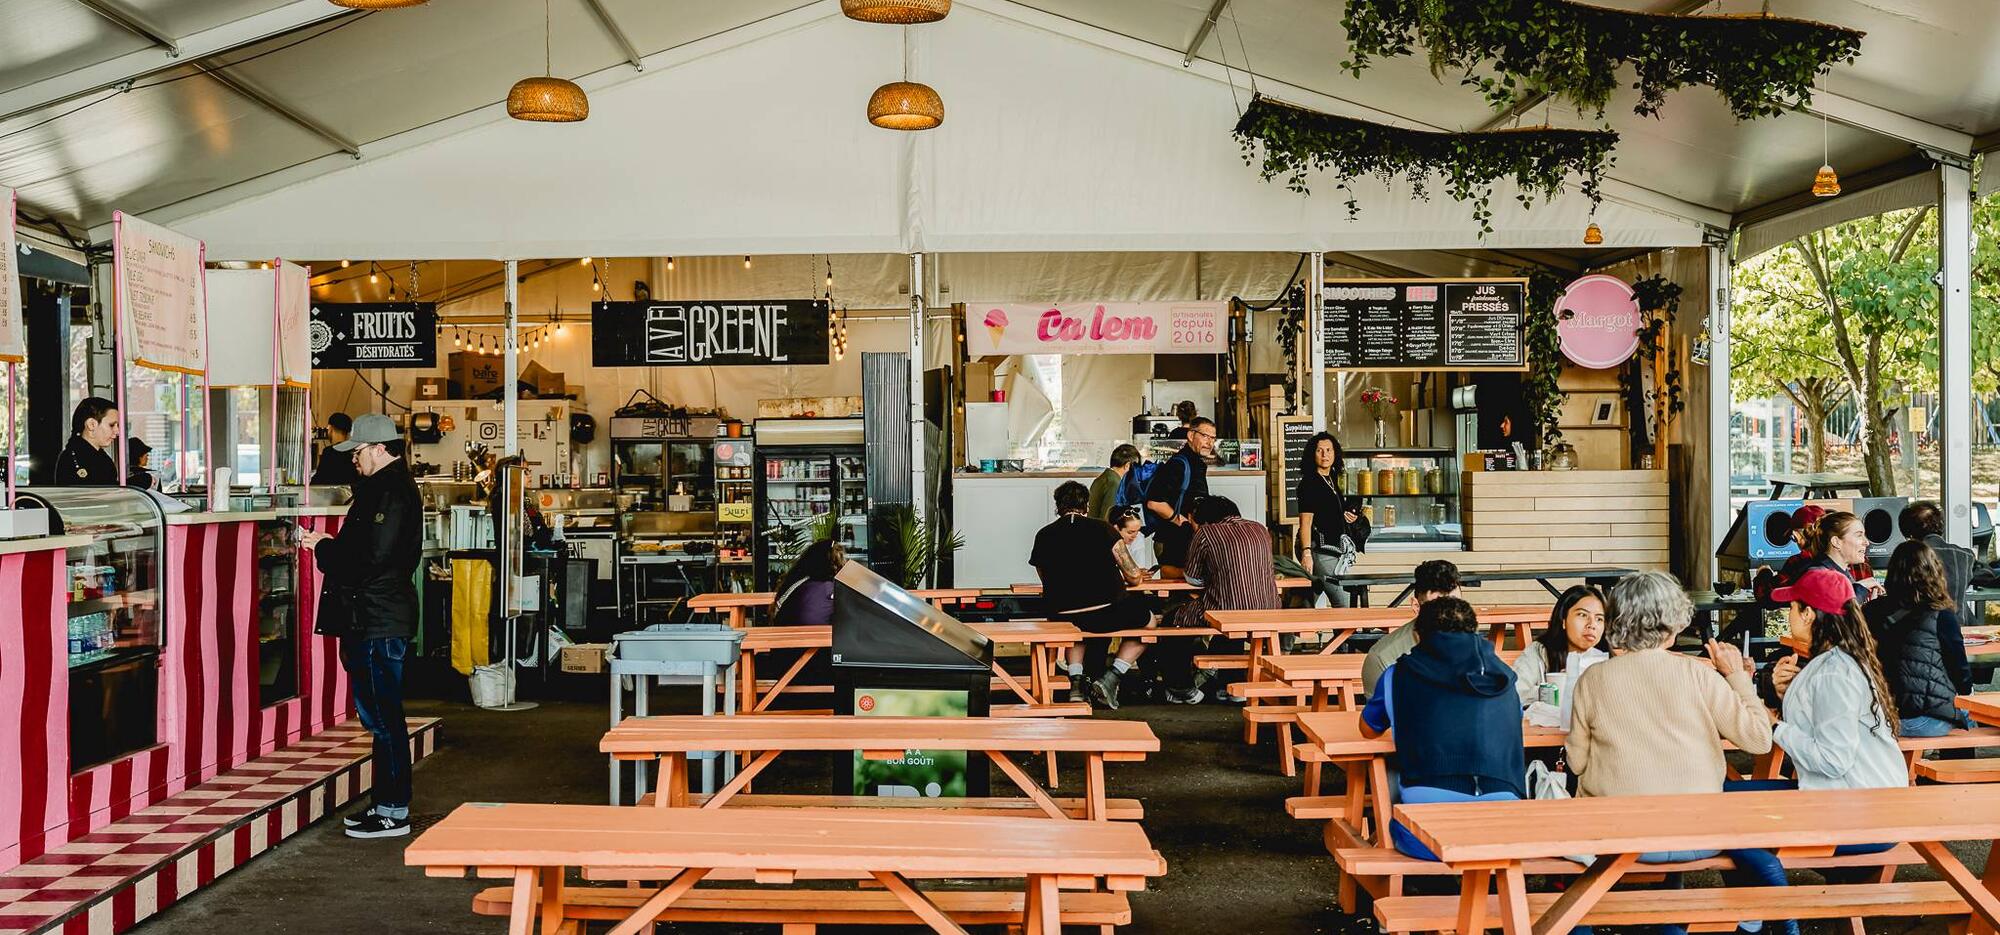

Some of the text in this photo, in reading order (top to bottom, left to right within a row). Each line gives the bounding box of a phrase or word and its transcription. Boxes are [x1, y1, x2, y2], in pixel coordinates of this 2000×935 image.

[1476, 286, 1496, 295] JUS
[1462, 302, 1510, 312] PRESSÉS
[352, 312, 416, 340] FRUITS
[1090, 305, 1158, 340] lem
[1173, 319, 1214, 330] depuis
[1567, 311, 1632, 332] Margot
[650, 309, 684, 359] AVE
[689, 305, 788, 362] GREENE
[1173, 331, 1214, 343] 2016
[356, 344, 414, 358] DÉSHYDRATÉS
[908, 755, 934, 765] GOÛT!
